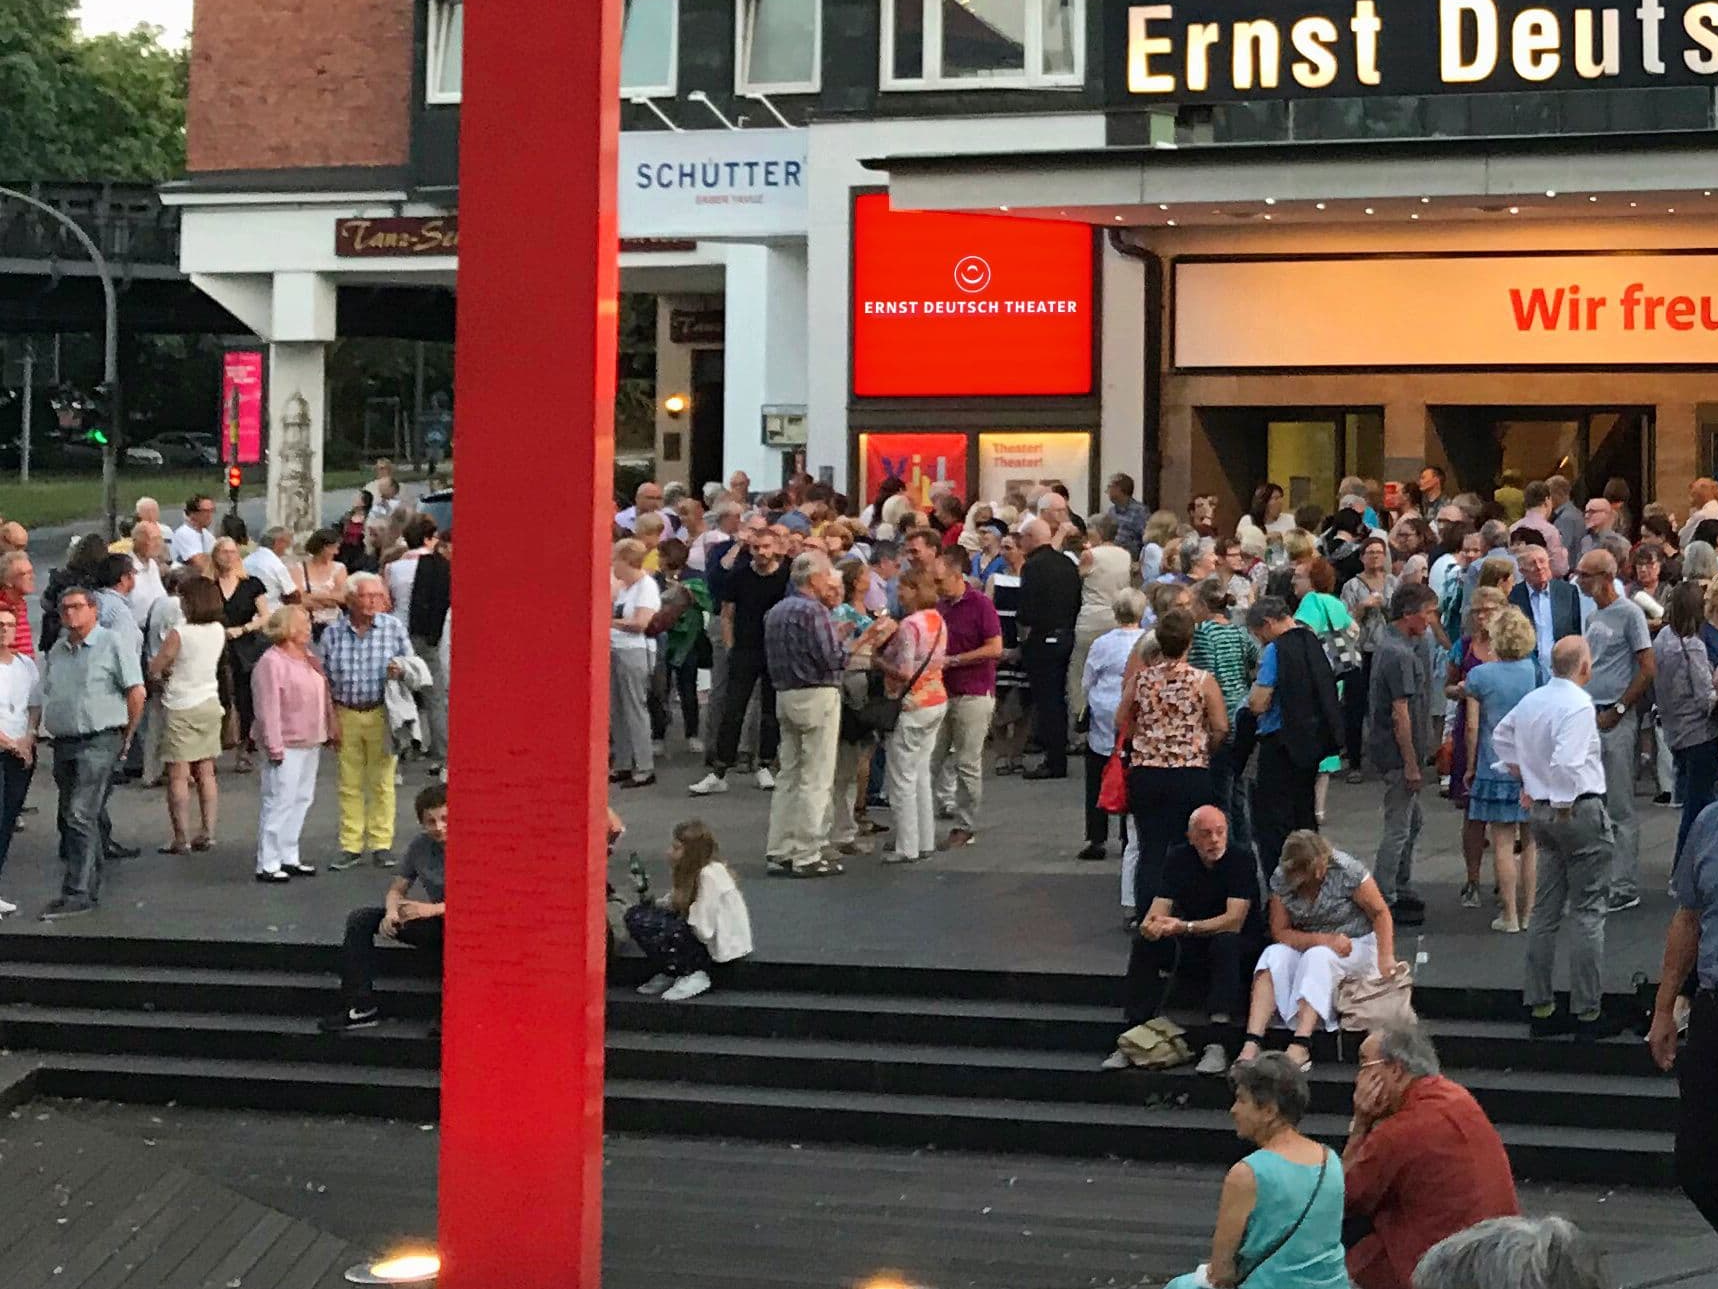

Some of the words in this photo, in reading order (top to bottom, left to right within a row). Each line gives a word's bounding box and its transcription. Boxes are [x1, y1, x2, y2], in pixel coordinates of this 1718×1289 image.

[864, 301, 918, 314] ERNST
[924, 301, 999, 314] DEUTSCH
[1005, 300, 1077, 313] THEATER
[1508, 284, 1606, 331] Wir
